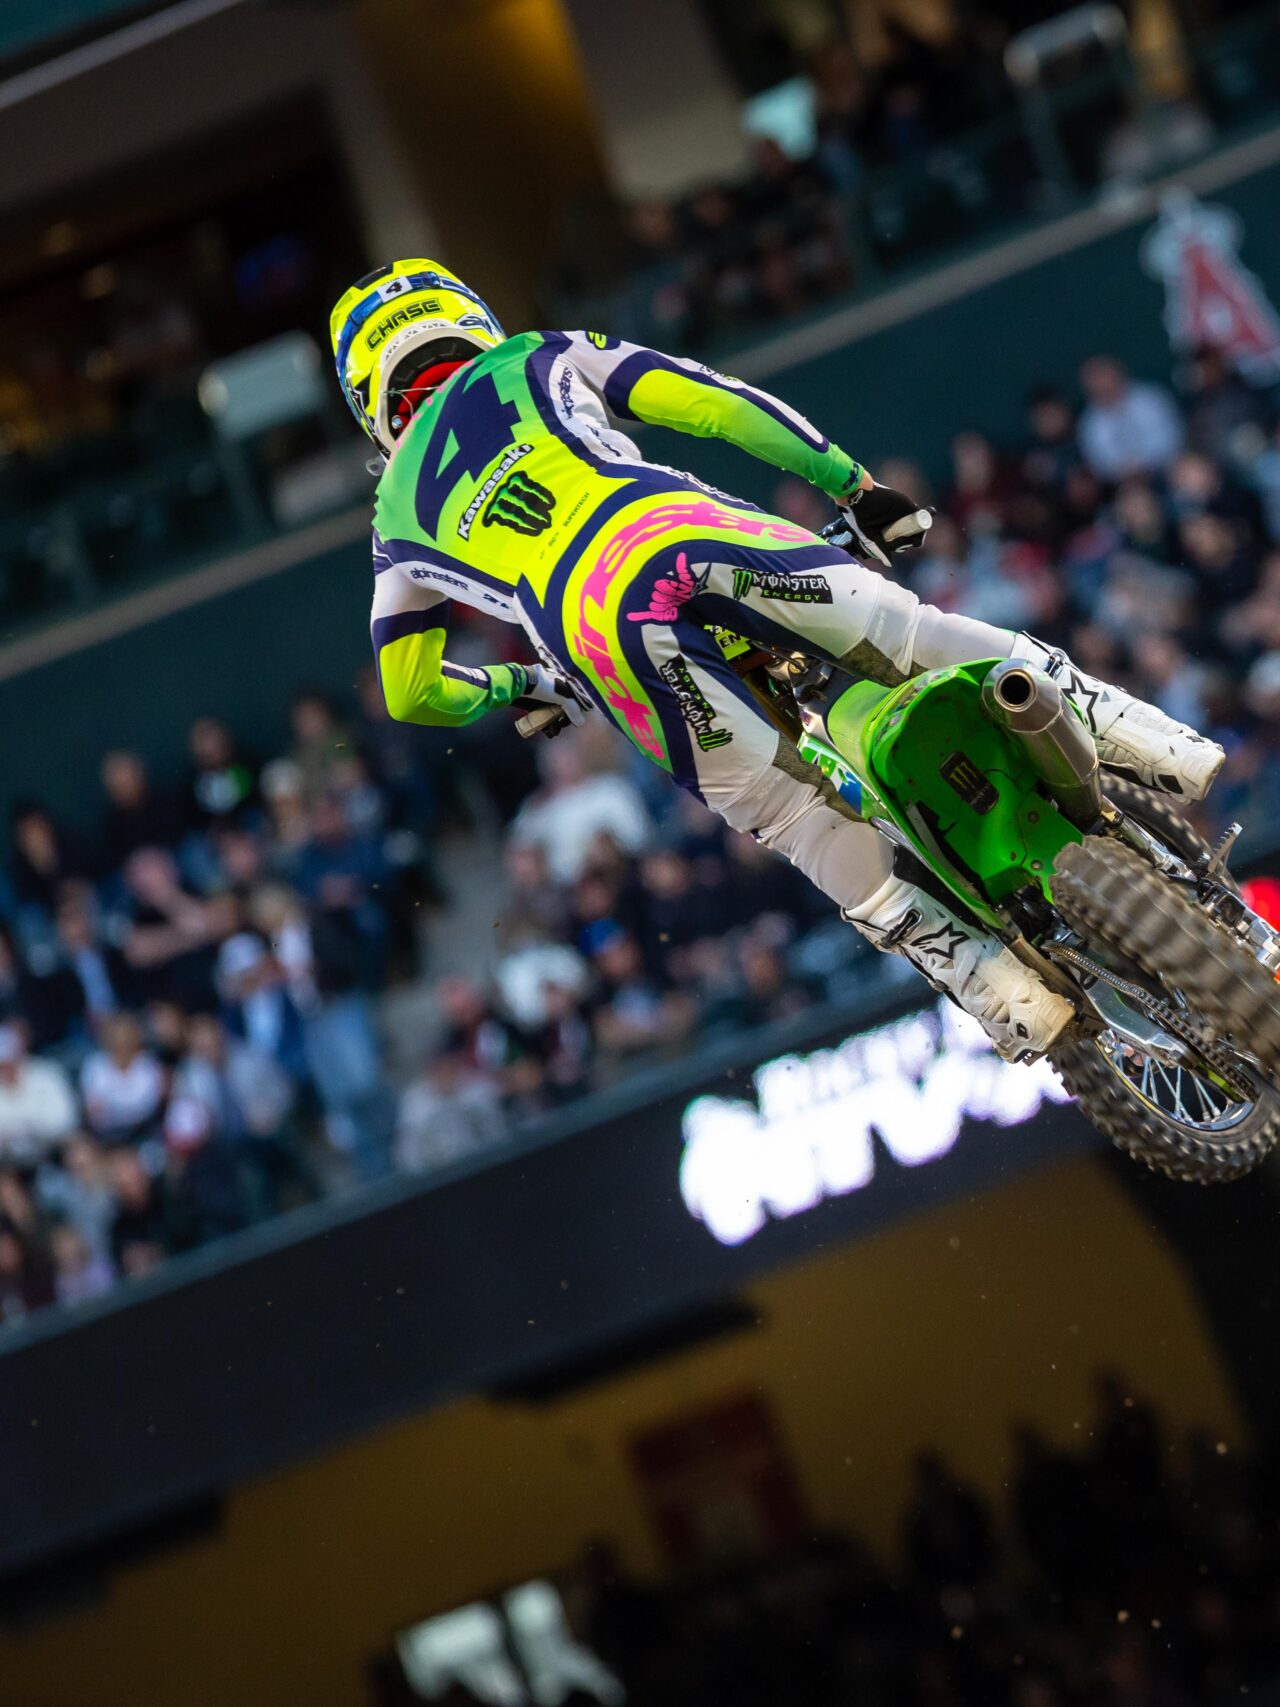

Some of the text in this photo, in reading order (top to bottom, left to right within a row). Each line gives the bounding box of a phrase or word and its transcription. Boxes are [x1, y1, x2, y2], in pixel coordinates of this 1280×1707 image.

[386, 282, 402, 294] 4
[367, 299, 440, 349] CHASE
[415, 360, 521, 541] 4
[458, 444, 532, 539] Kawasaki
[563, 492, 590, 527] SUPERTECH
[410, 567, 469, 590] alpinestars
[752, 574, 829, 590] MONSTER
[763, 589, 821, 601] ENERGY
[663, 661, 708, 735] MONSTER
